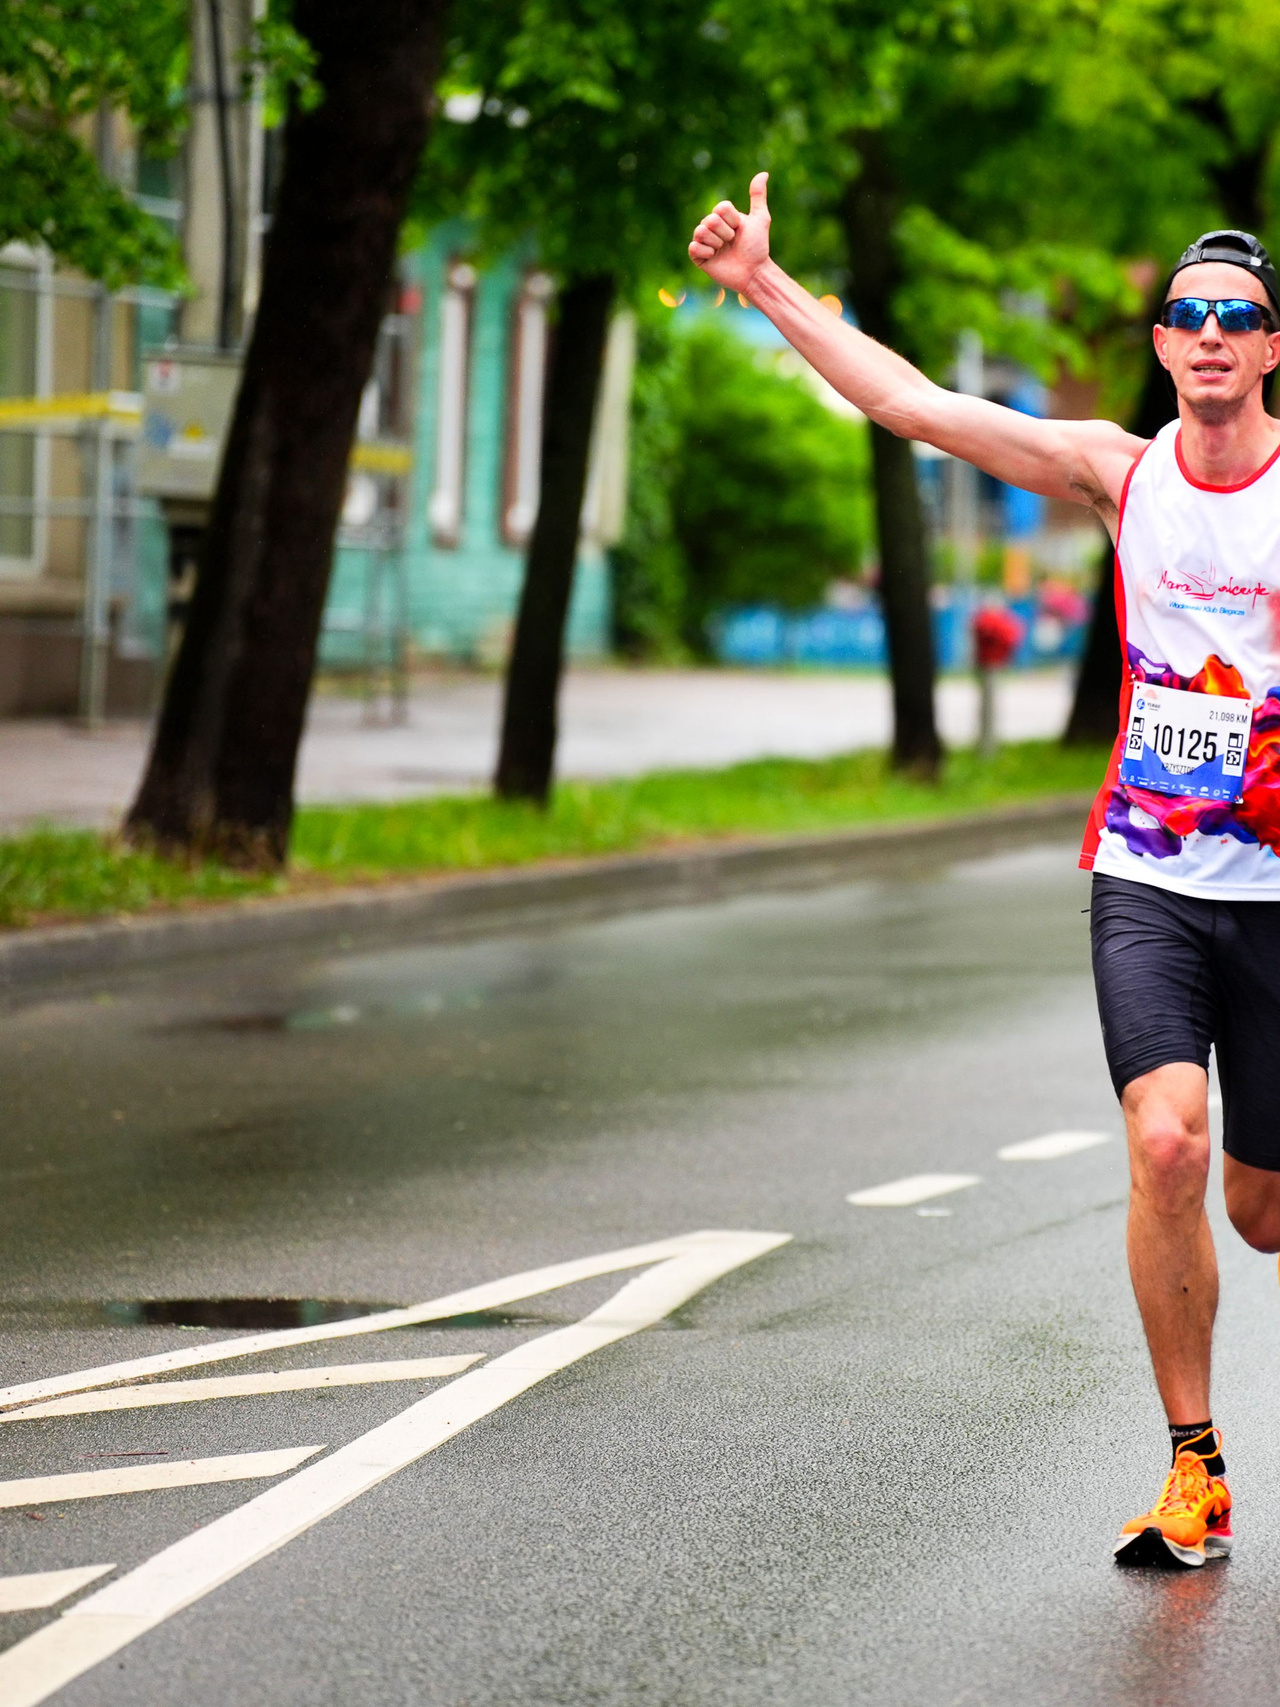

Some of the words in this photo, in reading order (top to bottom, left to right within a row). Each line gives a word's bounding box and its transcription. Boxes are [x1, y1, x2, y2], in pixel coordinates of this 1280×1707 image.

[1203, 605, 1218, 614] Klub
[1236, 714, 1248, 723] KM
[1153, 723, 1218, 763] 10125
